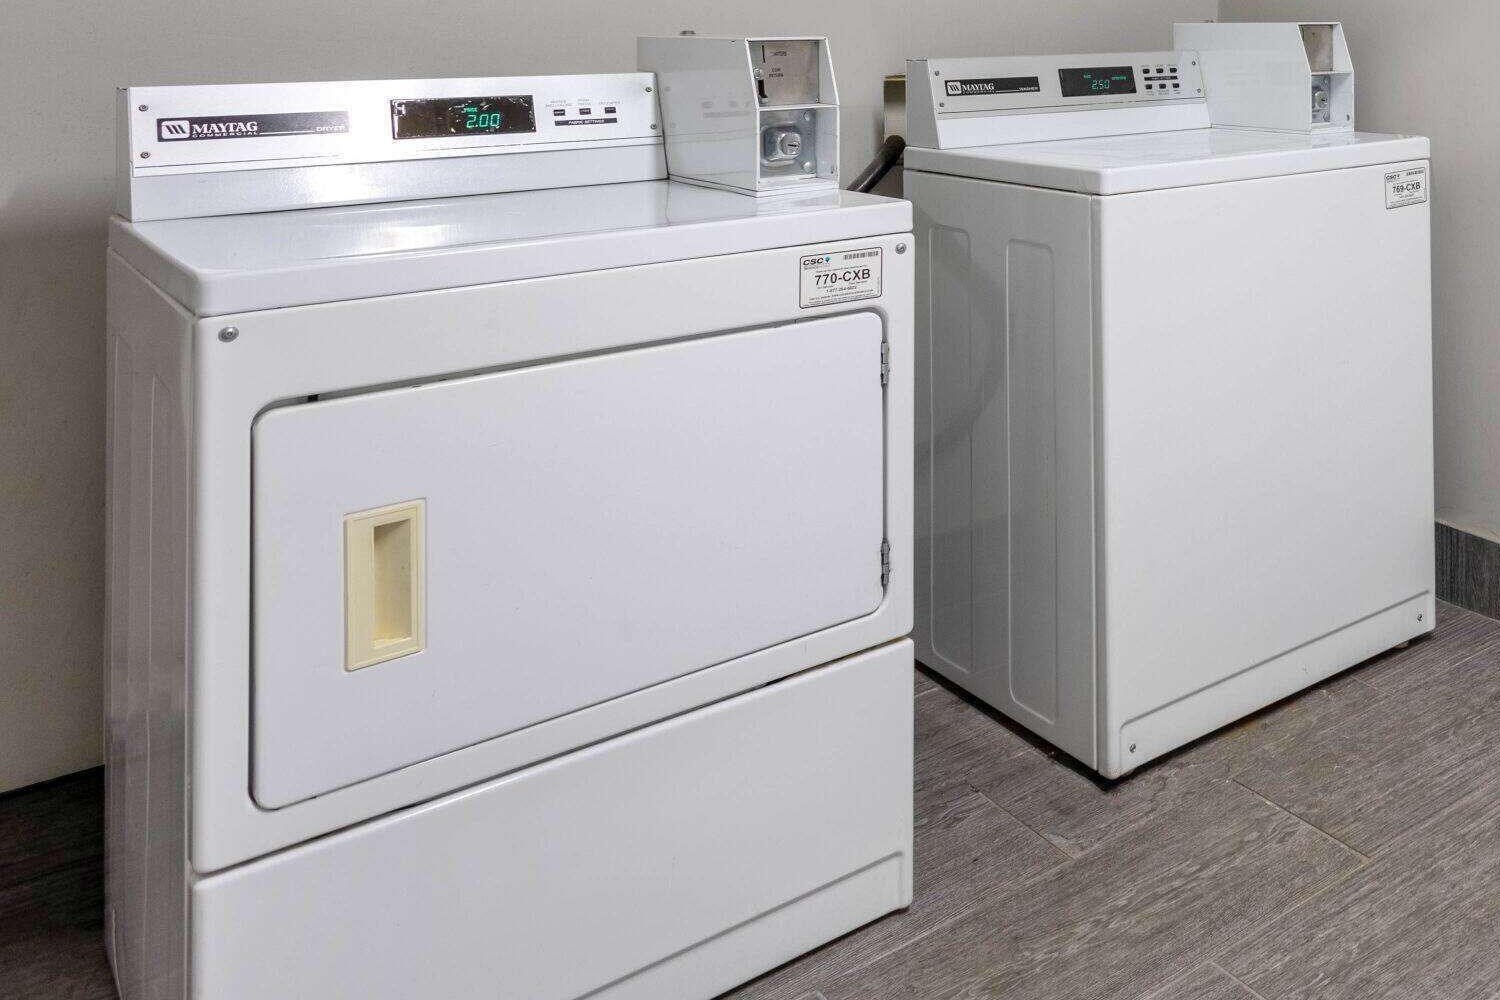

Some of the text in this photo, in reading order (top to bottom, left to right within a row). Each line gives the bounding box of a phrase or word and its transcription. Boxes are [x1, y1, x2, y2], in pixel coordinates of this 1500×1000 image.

[961, 83, 995, 91] MAYTAG
[466, 113, 500, 129] 2.00
[193, 121, 258, 134] MAYTAG
[316, 125, 346, 133] DRYER
[191, 131, 260, 139] COMMERCIAL
[1392, 181, 1421, 193] 769-CXB
[803, 257, 824, 266] CSC
[815, 268, 871, 286] 770-CXB
